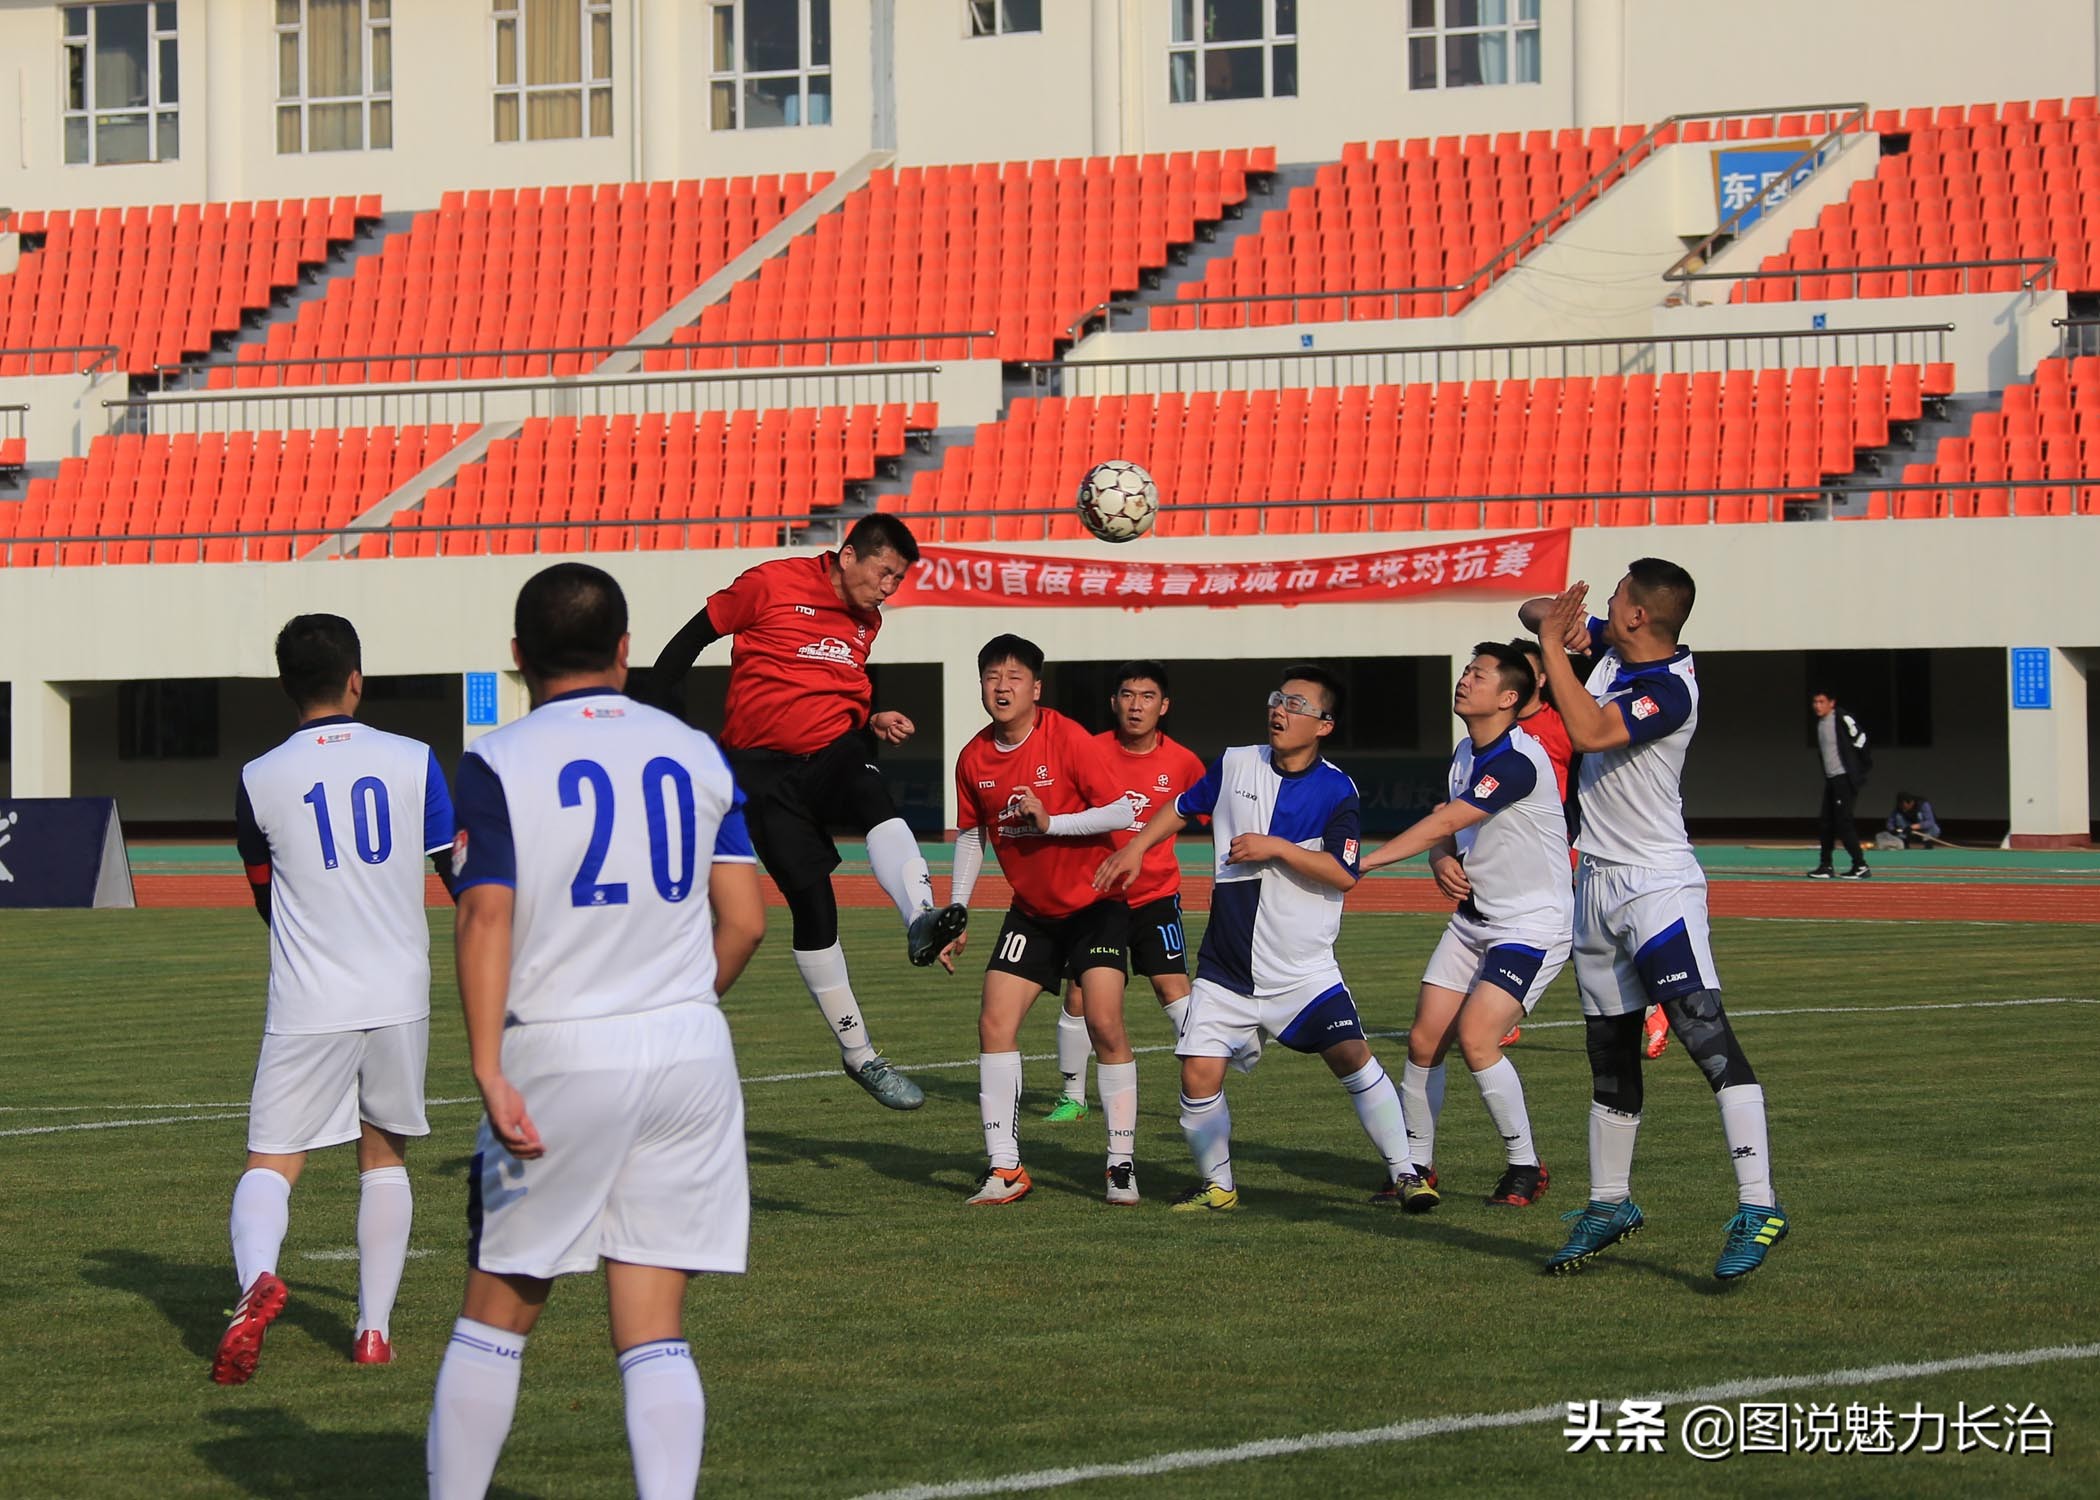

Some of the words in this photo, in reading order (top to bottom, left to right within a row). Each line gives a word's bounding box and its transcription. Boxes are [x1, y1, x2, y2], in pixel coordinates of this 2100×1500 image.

[303, 776, 392, 870] 10
[557, 756, 697, 908] 20
[999, 931, 1027, 963] 10
[1089, 946, 1120, 957] KELME
[1157, 923, 1182, 951] 10
